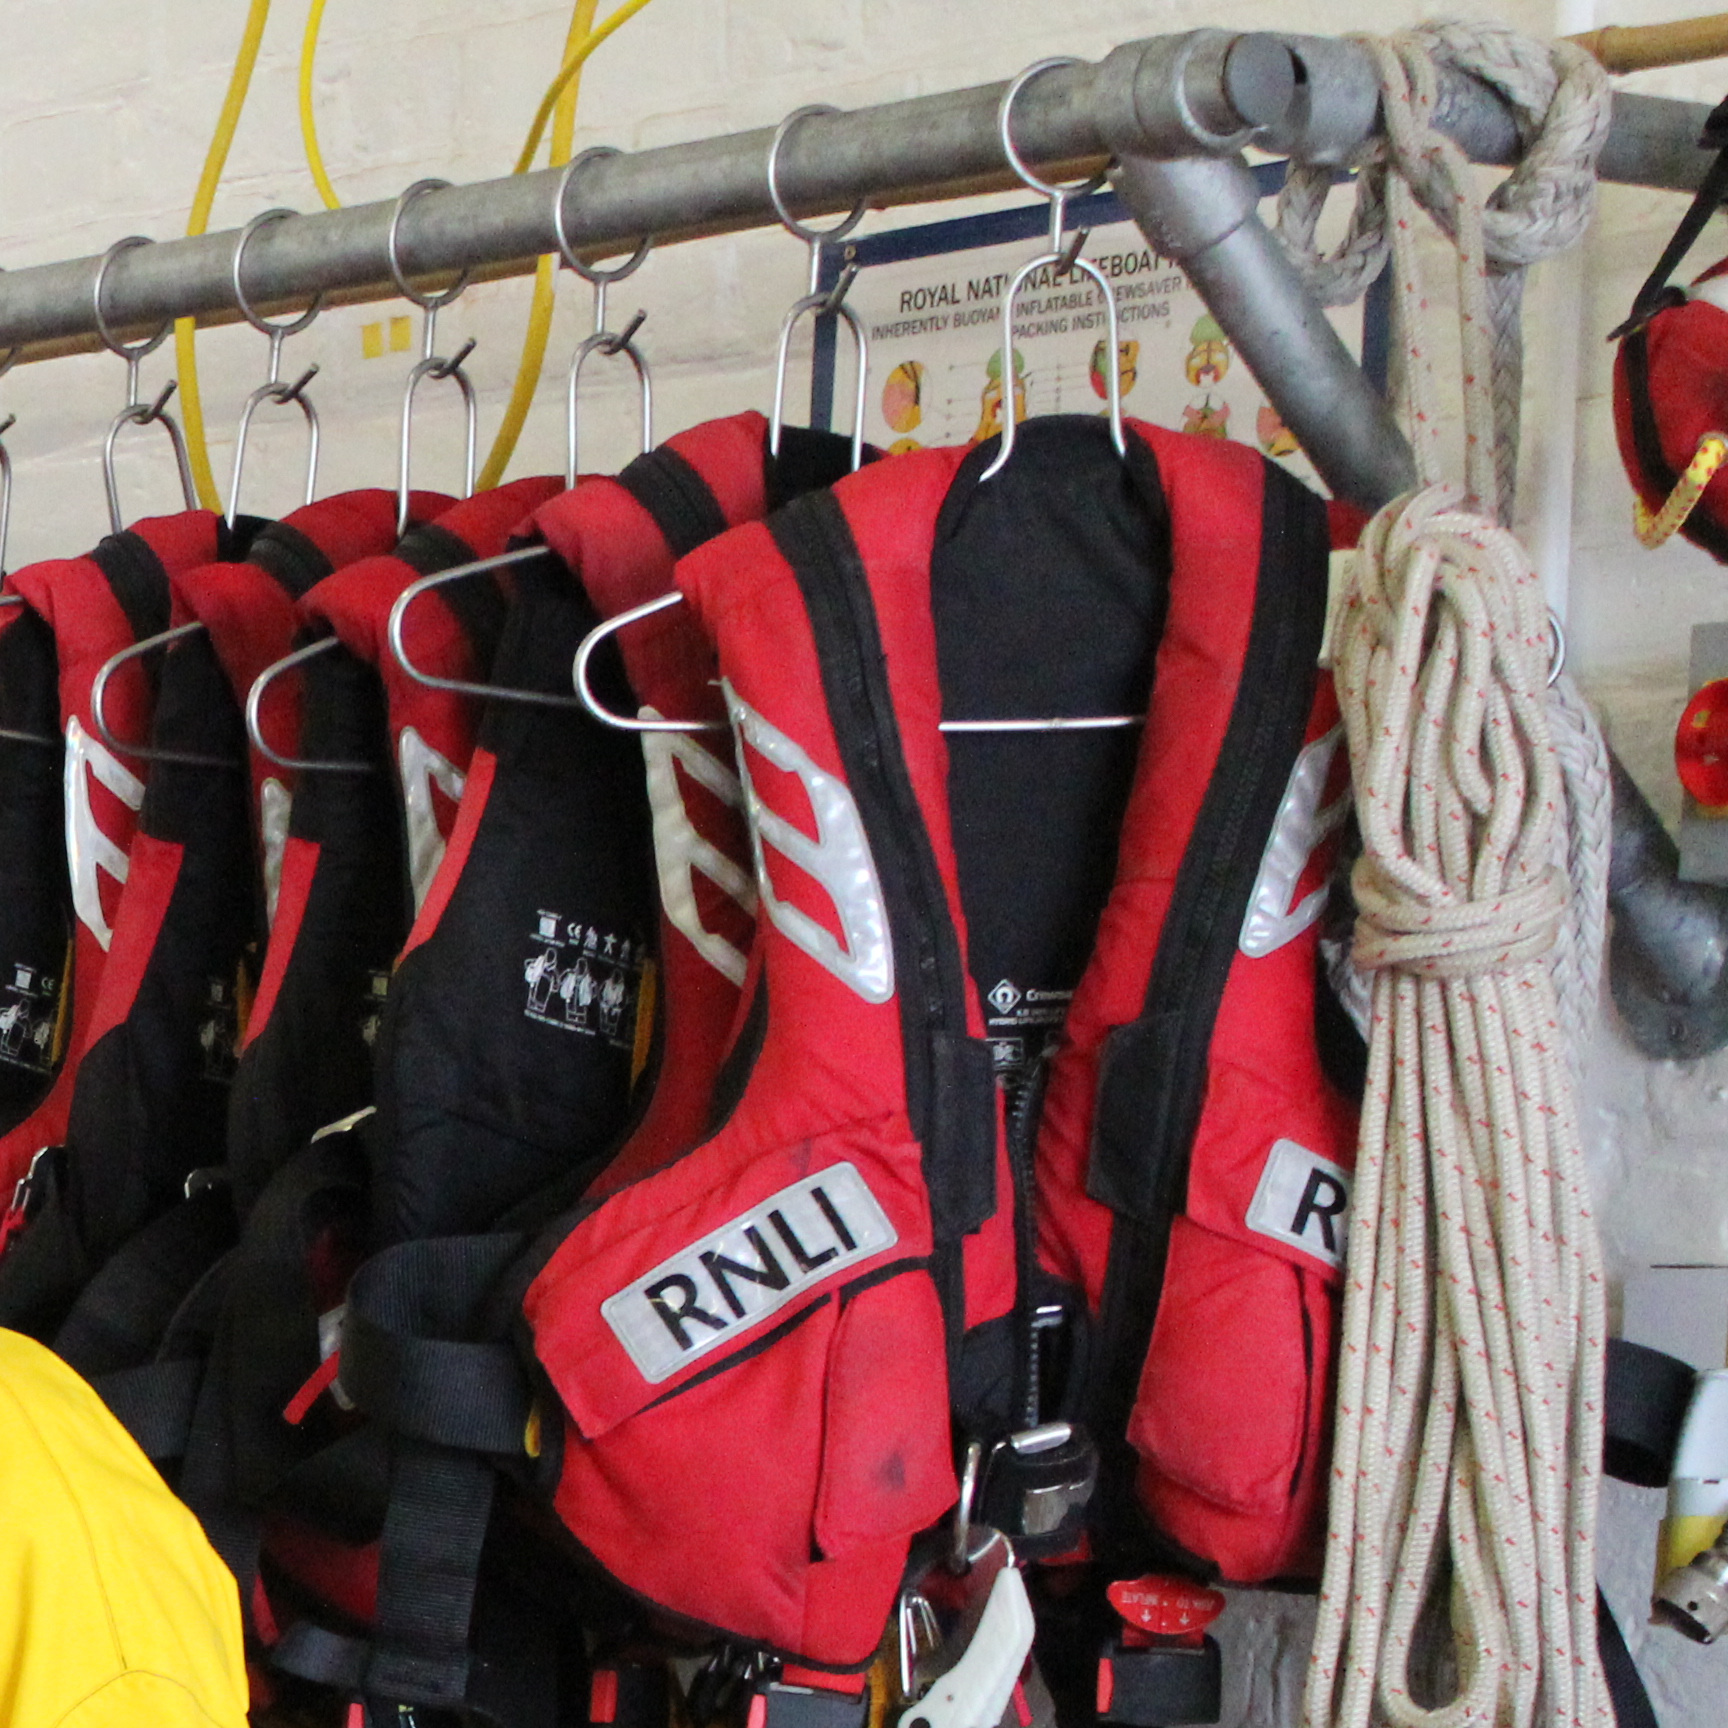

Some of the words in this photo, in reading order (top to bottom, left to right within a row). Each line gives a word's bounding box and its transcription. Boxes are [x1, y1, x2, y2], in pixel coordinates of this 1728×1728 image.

[872, 315, 950, 341] INHERENTLY
[1016, 293, 1093, 319] INFLATABLE
[1097, 276, 1182, 306] CEWSAVER
[900, 285, 961, 313] ROYAL
[966, 266, 1063, 302] NATNAL
[1069, 250, 1163, 287] LIEBOAT
[1012, 316, 1068, 340] PACKING
[1072, 301, 1171, 331] INSTCTIONS
[644, 1187, 858, 1351] RNLI
